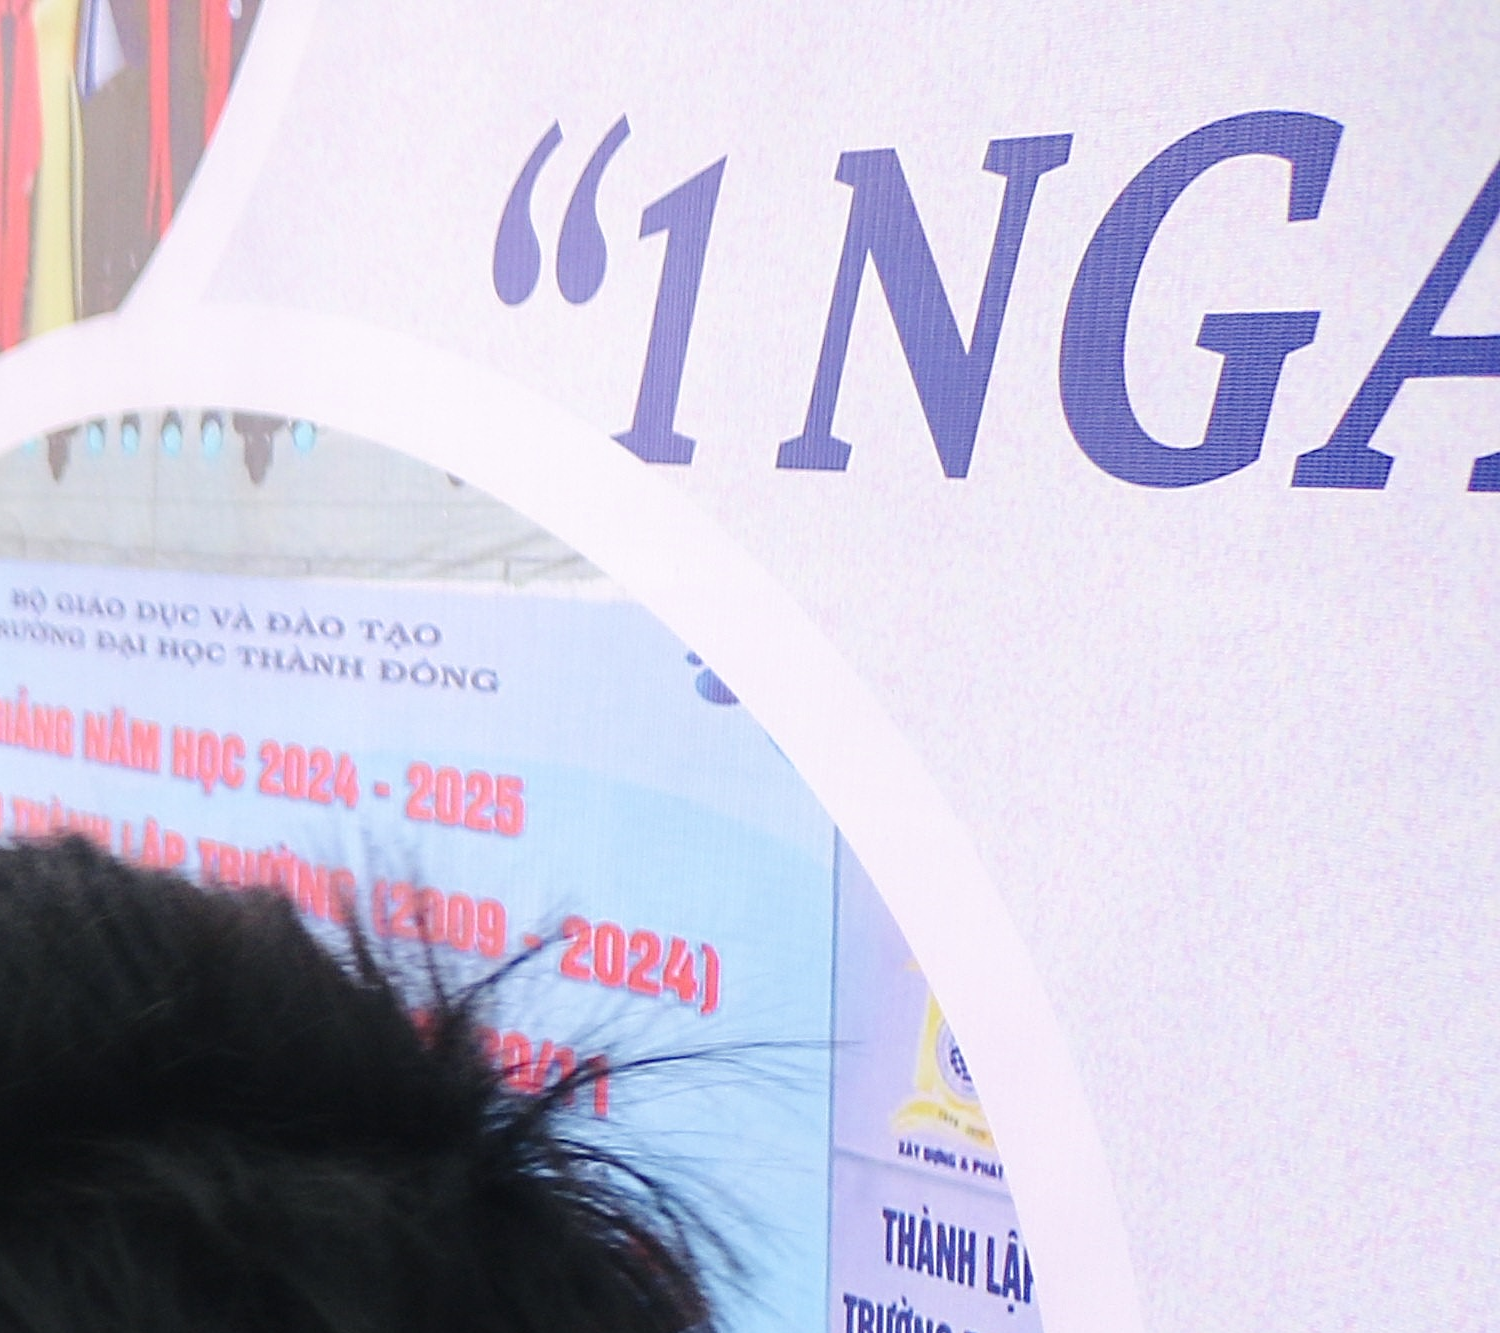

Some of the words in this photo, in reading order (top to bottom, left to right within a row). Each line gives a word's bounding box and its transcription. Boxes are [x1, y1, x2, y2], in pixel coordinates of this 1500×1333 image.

[98, 630, 147, 660] ĐẠI
[159, 636, 226, 667] HỌC
[236, 645, 364, 679] THÀNH
[380, 657, 498, 694] ĐÔNG
[137, 600, 200, 630] DỤC
[210, 603, 254, 632] VÀ
[267, 608, 345, 639] ĐÀO
[359, 618, 442, 649] TẠO
[84, 707, 161, 774] NĂM
[173, 724, 246, 794] HỌC
[258, 739, 360, 809] 2024
[406, 761, 526, 837] 2025
[560, 915, 722, 1016] 2024)
[882, 1204, 977, 1288] THÀNH
